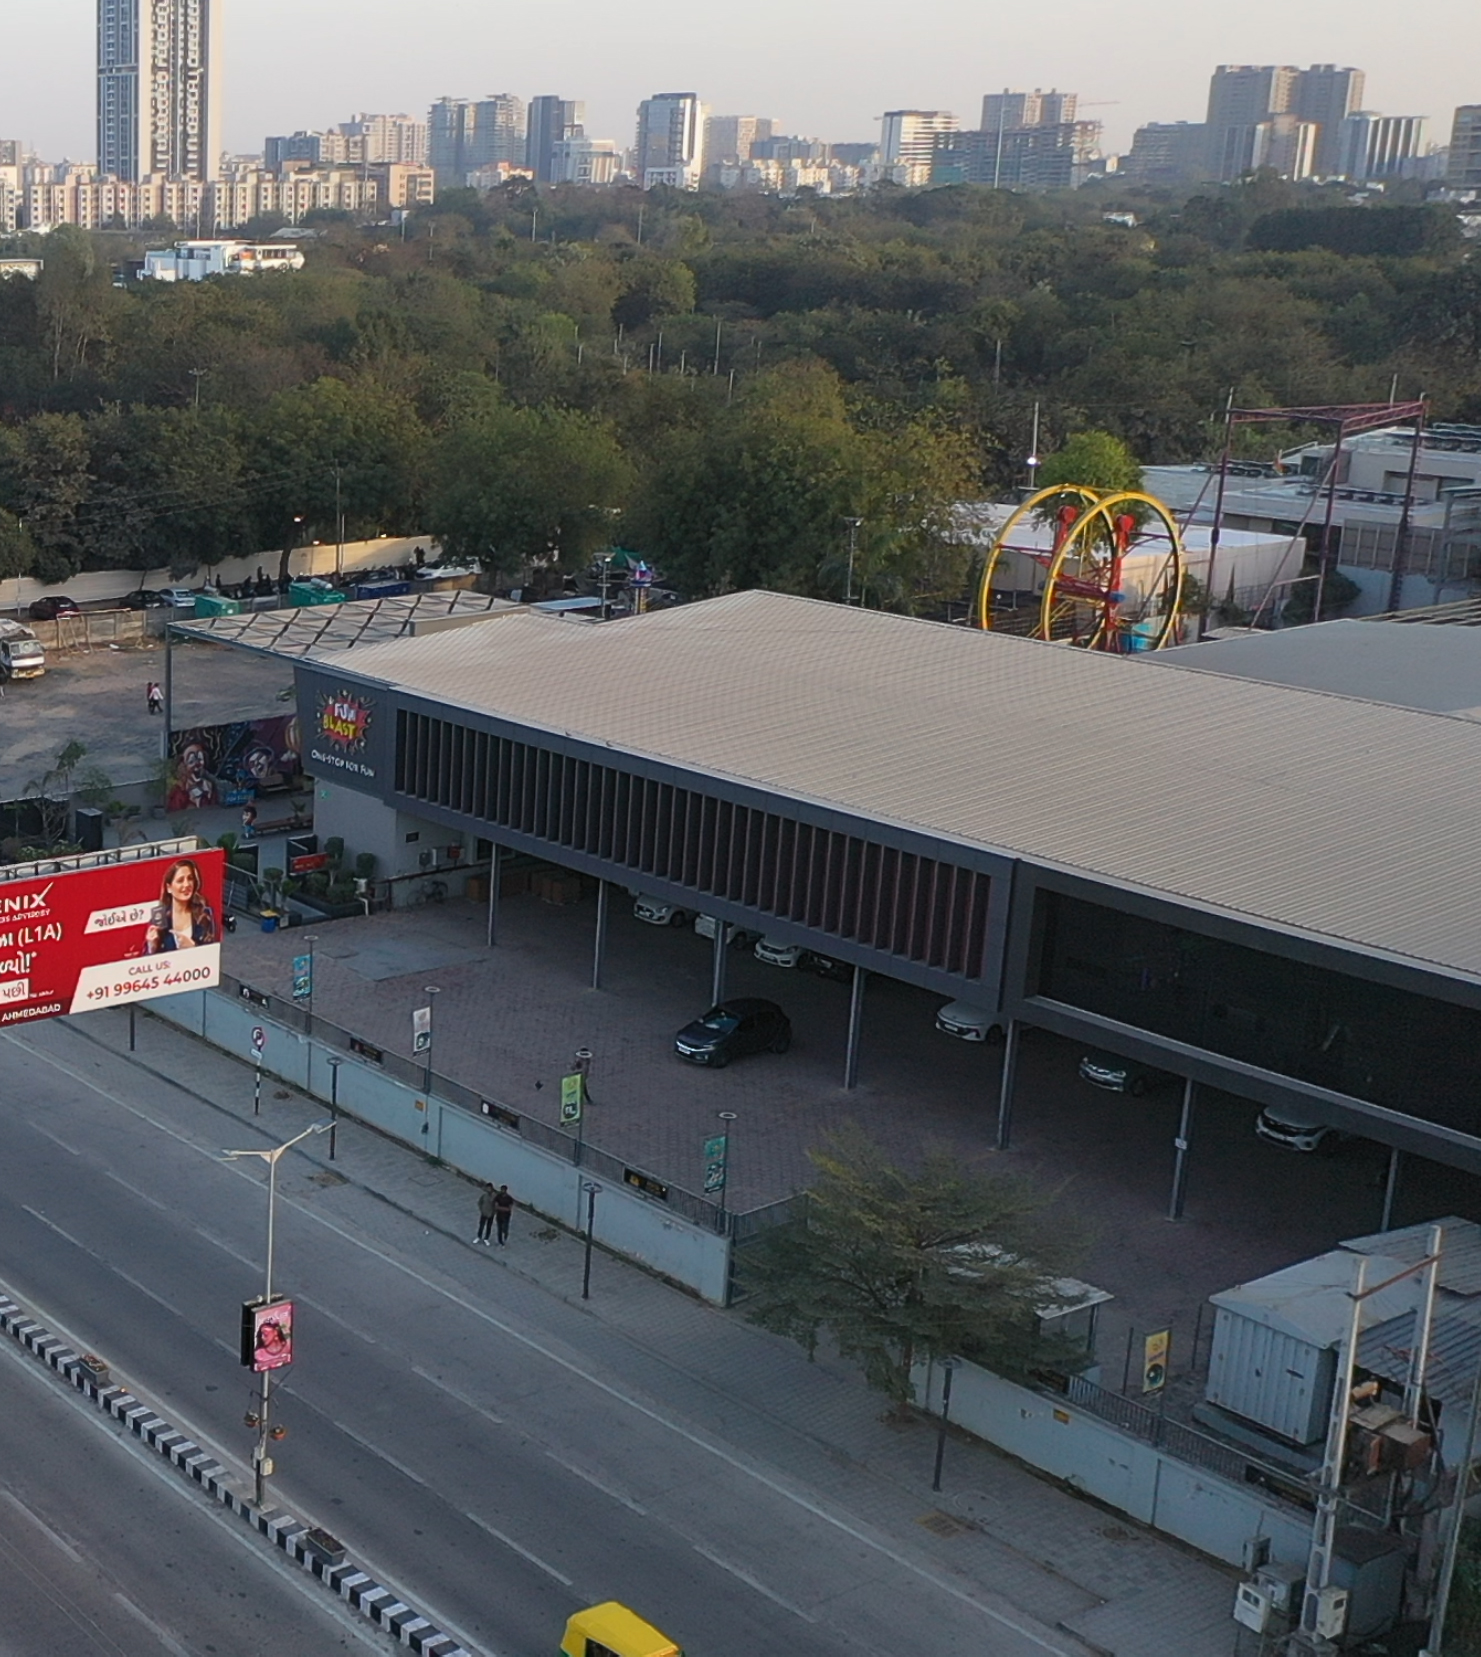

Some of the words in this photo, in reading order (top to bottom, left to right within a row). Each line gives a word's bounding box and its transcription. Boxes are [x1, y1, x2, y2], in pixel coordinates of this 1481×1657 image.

[334, 703, 357, 722] FUN
[323, 714, 356, 739] BLAST
[94, 911, 127, 927] જોઈએ
[18, 922, 62, 947] (L1A)
[128, 964, 153, 976] CALL
[3, 981, 26, 998] પછી
[86, 986, 110, 1000] +91
[113, 976, 159, 997] 99645
[163, 966, 211, 985] 44000
[2, 1003, 61, 1022] AHMEDABAD
